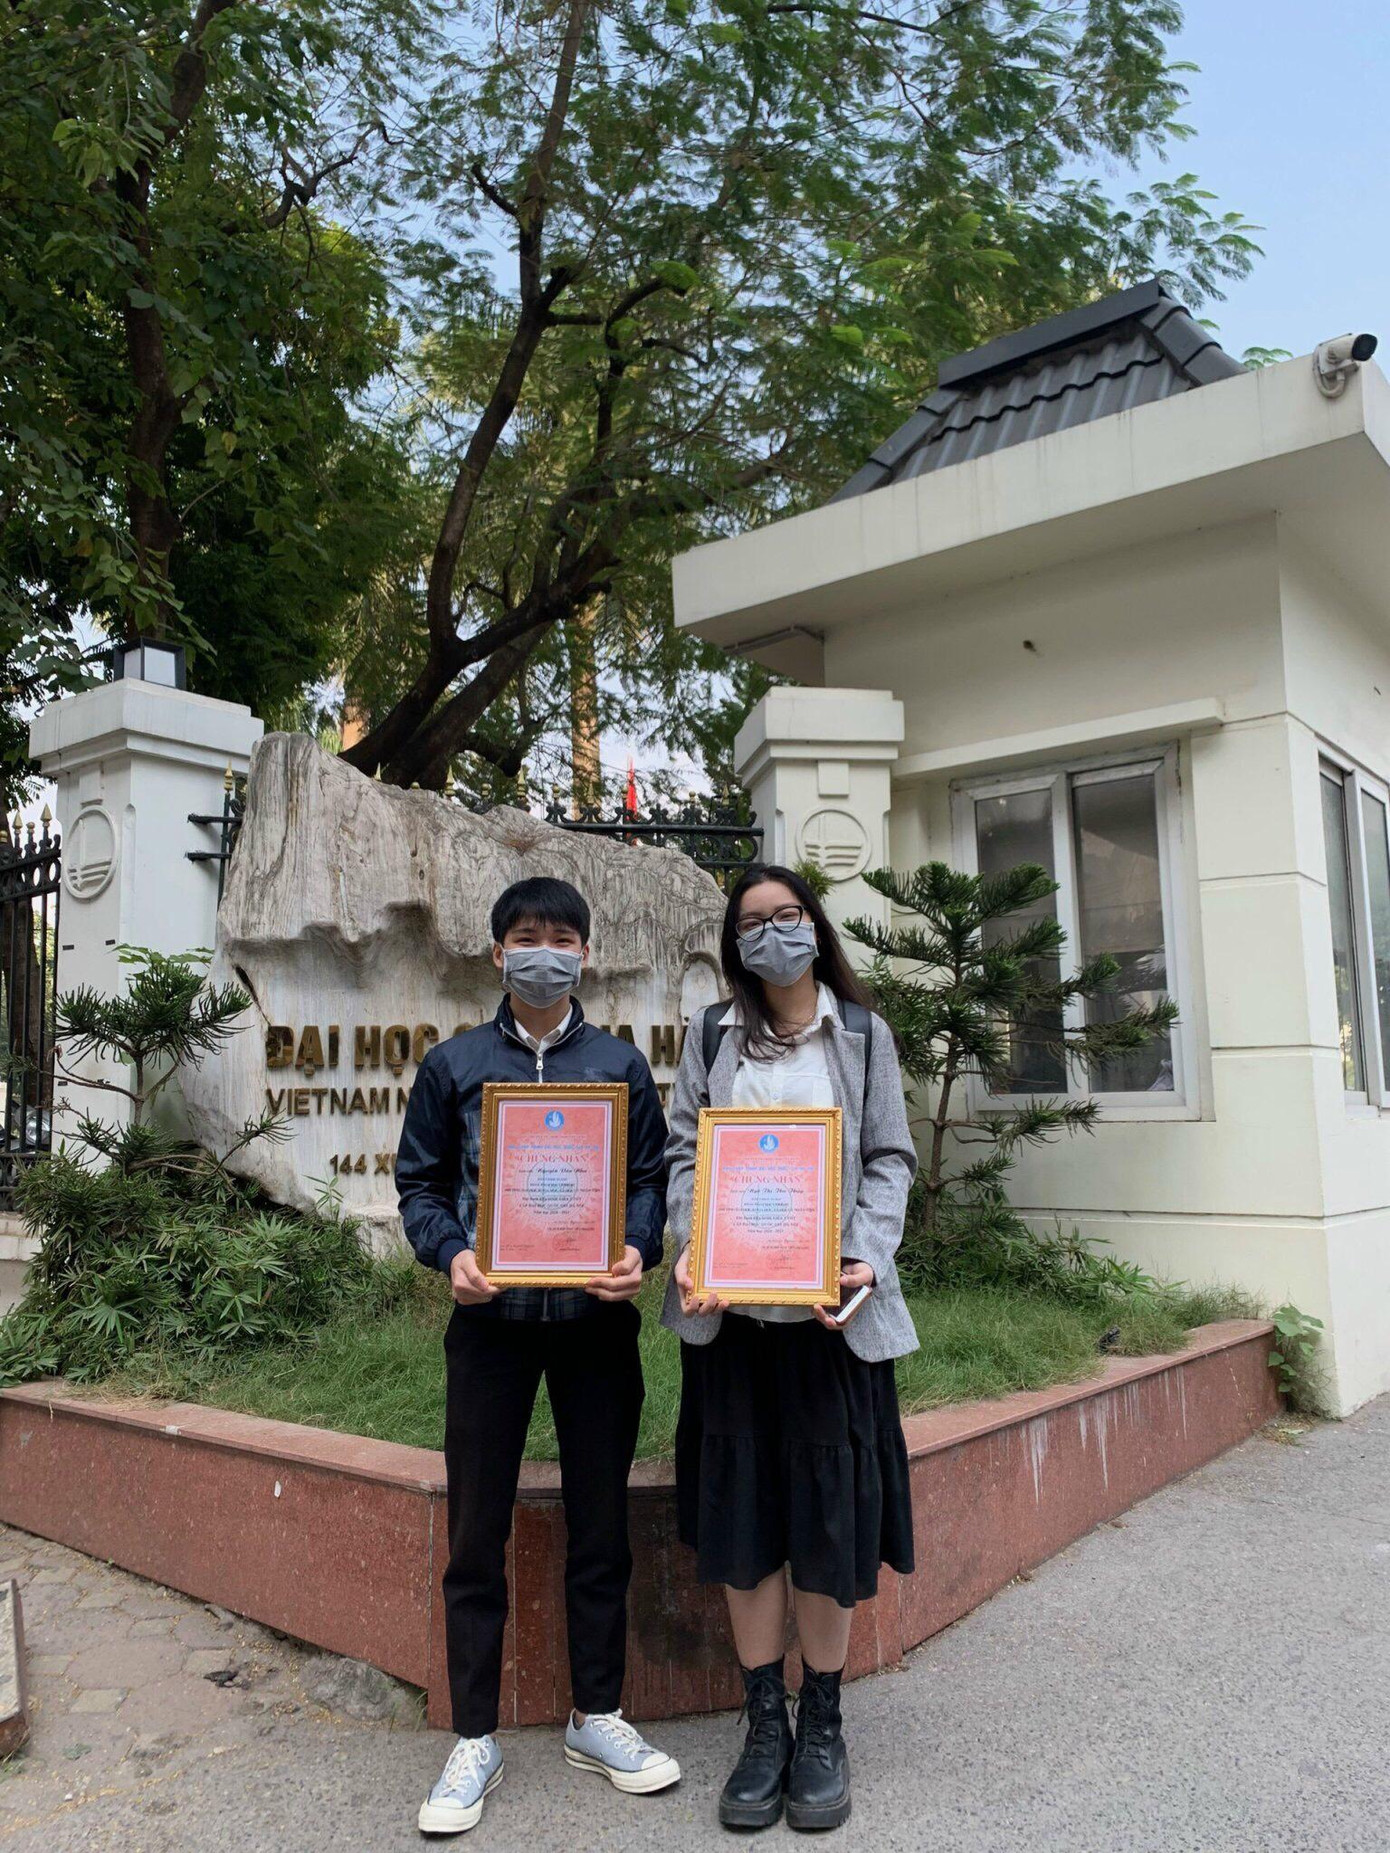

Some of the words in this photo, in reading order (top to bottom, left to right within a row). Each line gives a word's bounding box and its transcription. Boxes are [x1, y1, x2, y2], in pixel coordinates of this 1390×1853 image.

[265, 1025, 339, 1077] ĐẠI
[354, 1024, 439, 1077] HỌC
[266, 1087, 390, 1115] VIETNAM
[330, 1153, 367, 1175] 144
